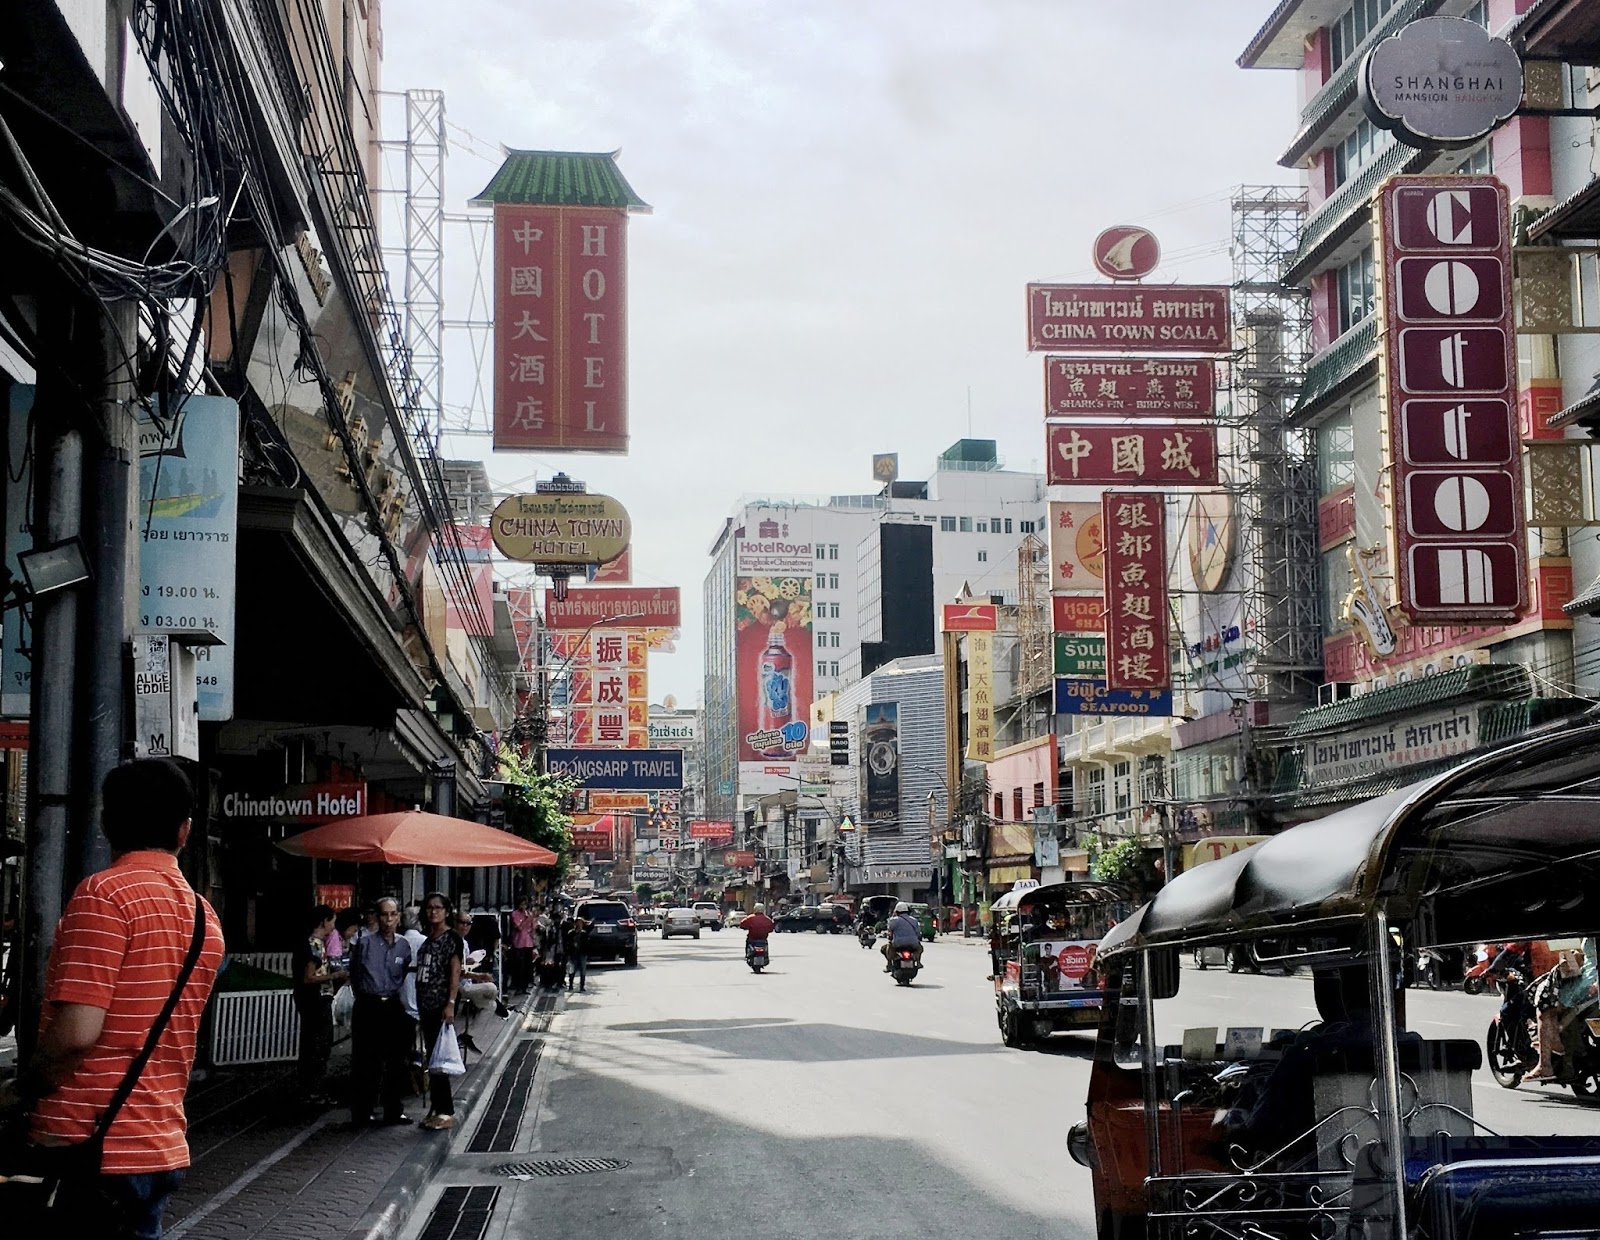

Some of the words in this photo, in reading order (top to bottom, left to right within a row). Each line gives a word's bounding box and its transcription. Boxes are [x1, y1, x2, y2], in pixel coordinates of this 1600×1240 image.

[1394, 76, 1503, 90] SHANGHAI
[1394, 92, 1448, 102] MANSION
[509, 219, 547, 432] 中國大酒店
[580, 224, 608, 433] HOTEL
[1041, 324, 1097, 340] CHINA
[1101, 325, 1155, 340] TOWN
[1159, 325, 1219, 340] SCALA
[1059, 399, 1104, 409] SHARK'S
[1107, 401, 1124, 409] FIN
[1136, 400, 1171, 410] BIRD'S
[1173, 401, 1200, 410] NEST
[1058, 430, 1200, 479] 中國城
[499, 517, 561, 538] CHINA
[568, 518, 624, 538] TOWN
[173, 529, 229, 542] เยาวราช
[531, 540, 590, 555] HOTEL
[740, 542, 775, 553] Hotel
[776, 542, 811, 556] Royal
[157, 586, 197, 598] 19.00
[1115, 502, 1159, 682] 銀都魚翅酒樓
[156, 615, 197, 628] 03.00
[136, 673, 168, 685] ALICE
[136, 683, 170, 695] EDDIE
[596, 636, 624, 742] 振成豐
[1079, 702, 1149, 713] SEAFOOD
[780, 721, 807, 742] 10
[631, 760, 679, 777] TRAVEL
[1310, 765, 1334, 781] CHINA
[1334, 761, 1358, 777] TOWN
[1357, 757, 1387, 772] SCALA
[223, 792, 313, 817] Chinatown
[316, 790, 361, 816] Hotel
[873, 811, 894, 819] MIDO
[1019, 880, 1037, 888] TAXI
